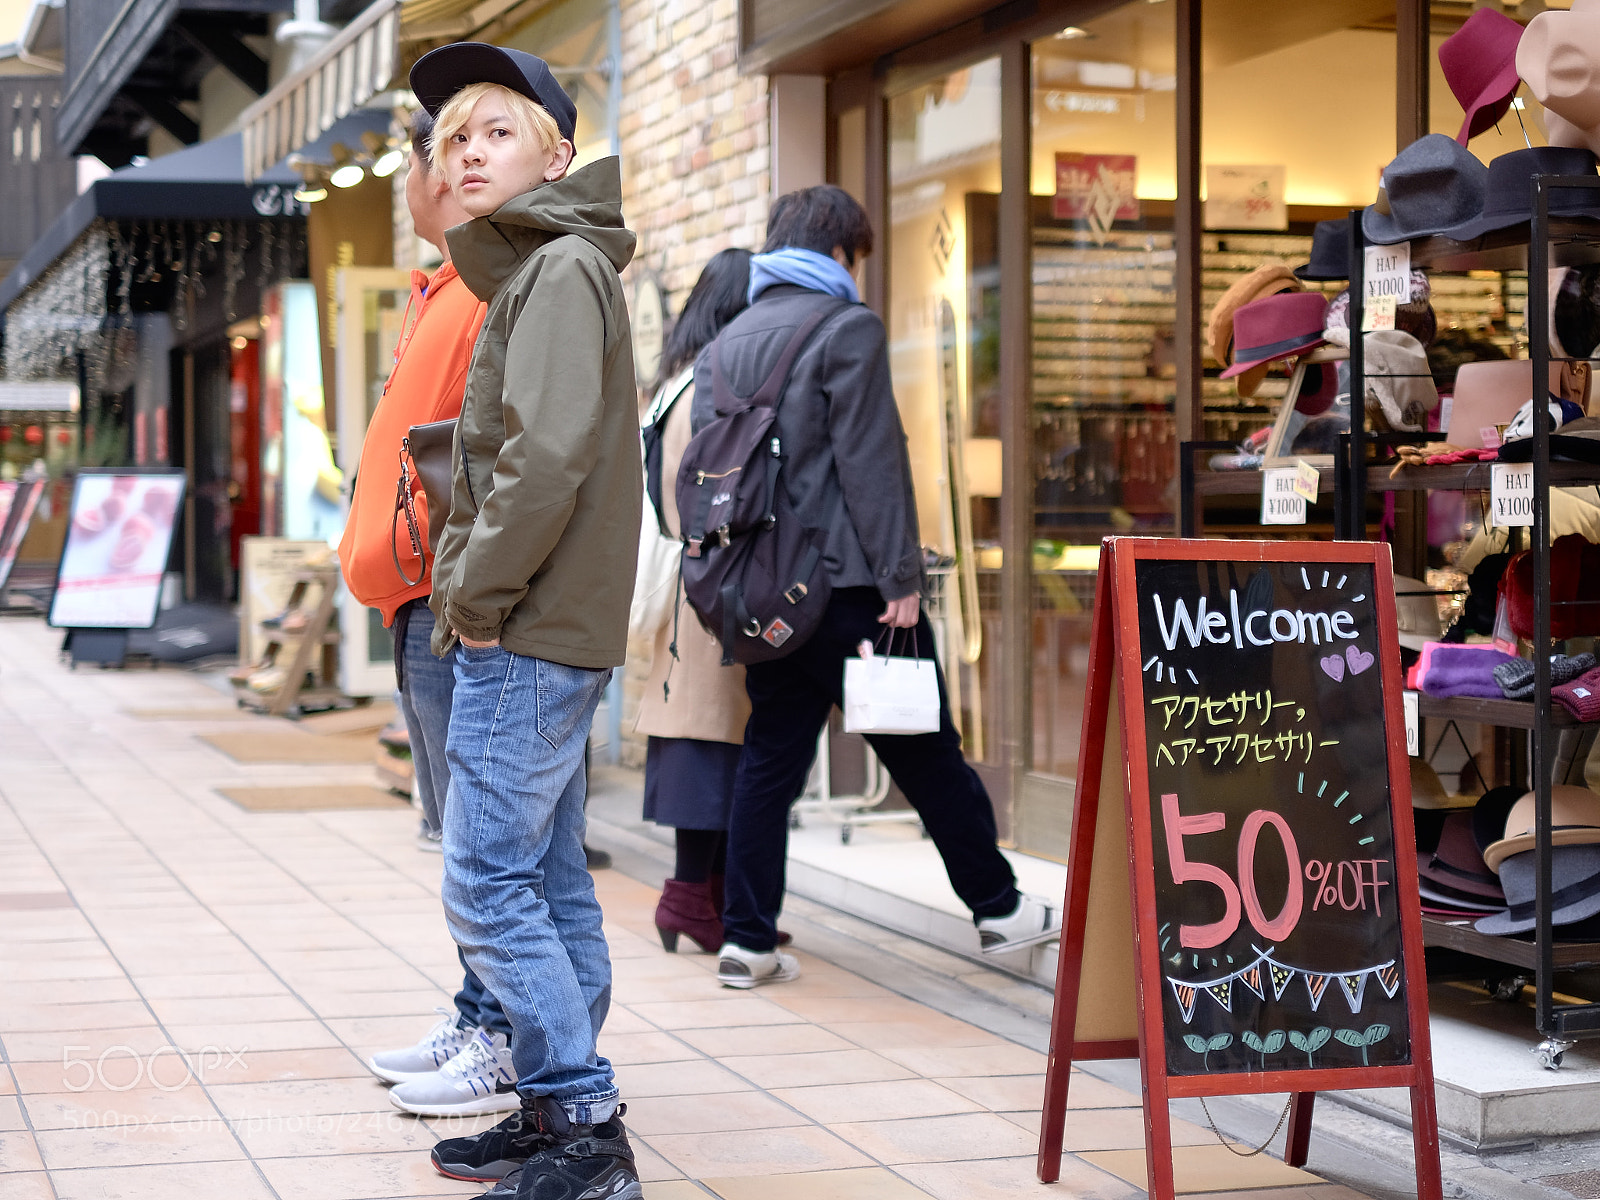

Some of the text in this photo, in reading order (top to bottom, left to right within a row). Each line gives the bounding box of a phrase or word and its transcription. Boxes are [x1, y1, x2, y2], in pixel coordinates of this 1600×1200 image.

[1376, 256, 1398, 273] HAT
[1368, 276, 1404, 297] ¥1000
[1276, 478, 1296, 492] HAT
[1505, 473, 1531, 490] HAT
[1269, 498, 1303, 515] ¥1000
[1152, 588, 1360, 651] Welcome
